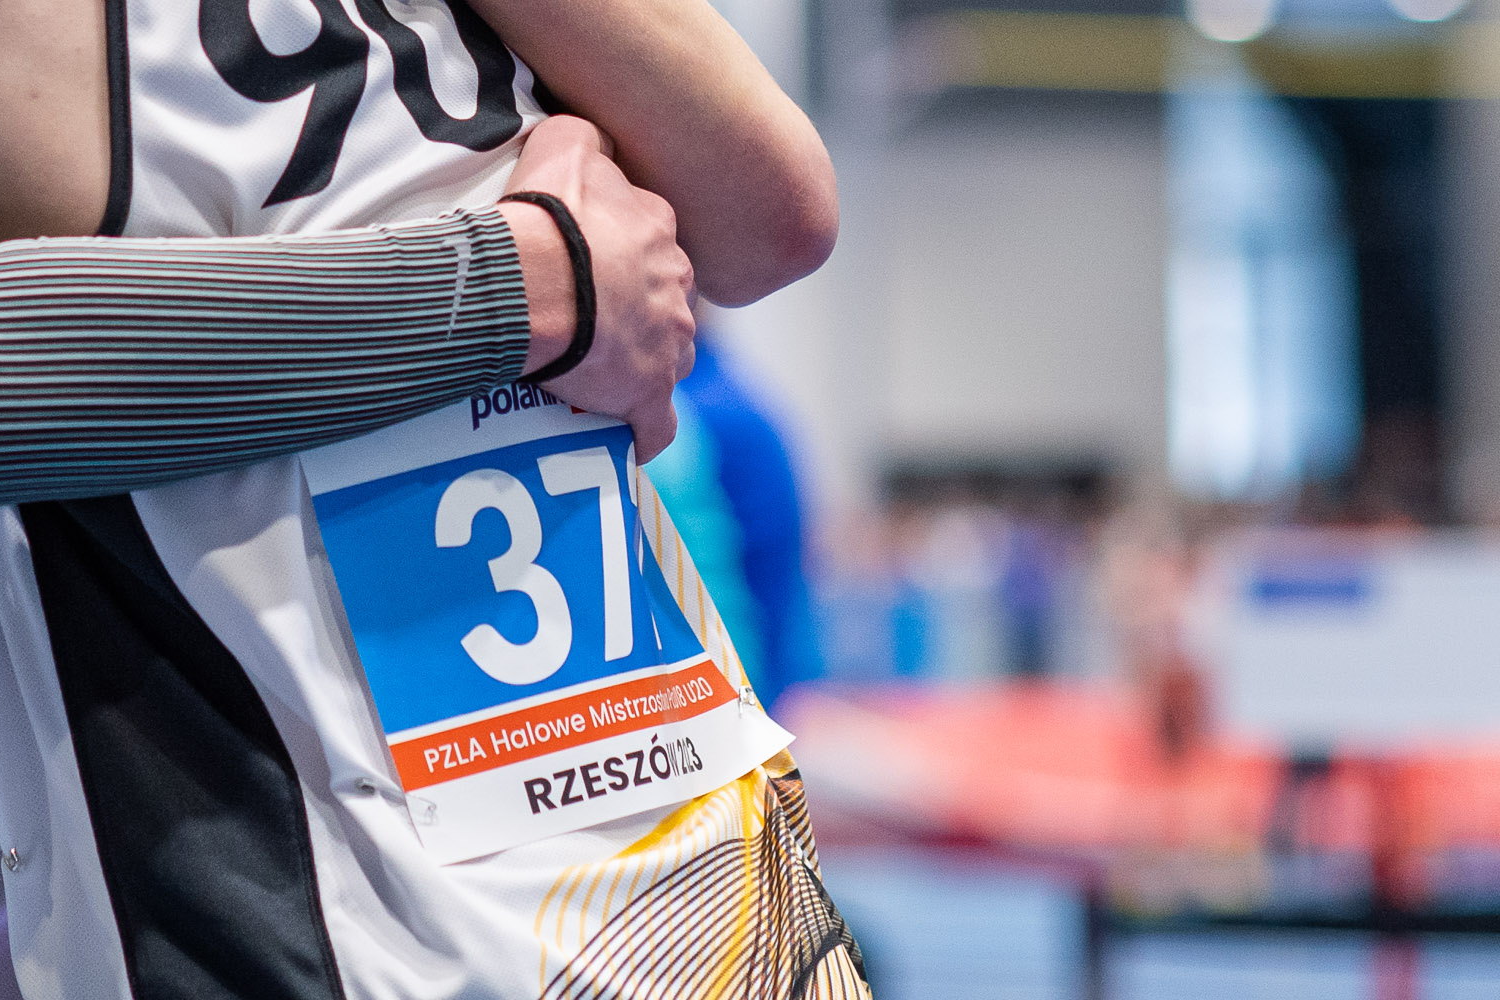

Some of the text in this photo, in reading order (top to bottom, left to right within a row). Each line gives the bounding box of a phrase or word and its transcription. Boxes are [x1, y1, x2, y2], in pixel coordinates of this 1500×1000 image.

[435, 441, 662, 685] 37
[424, 737, 487, 773] PZLA
[490, 713, 586, 755] Halowe
[683, 676, 713, 704] U20
